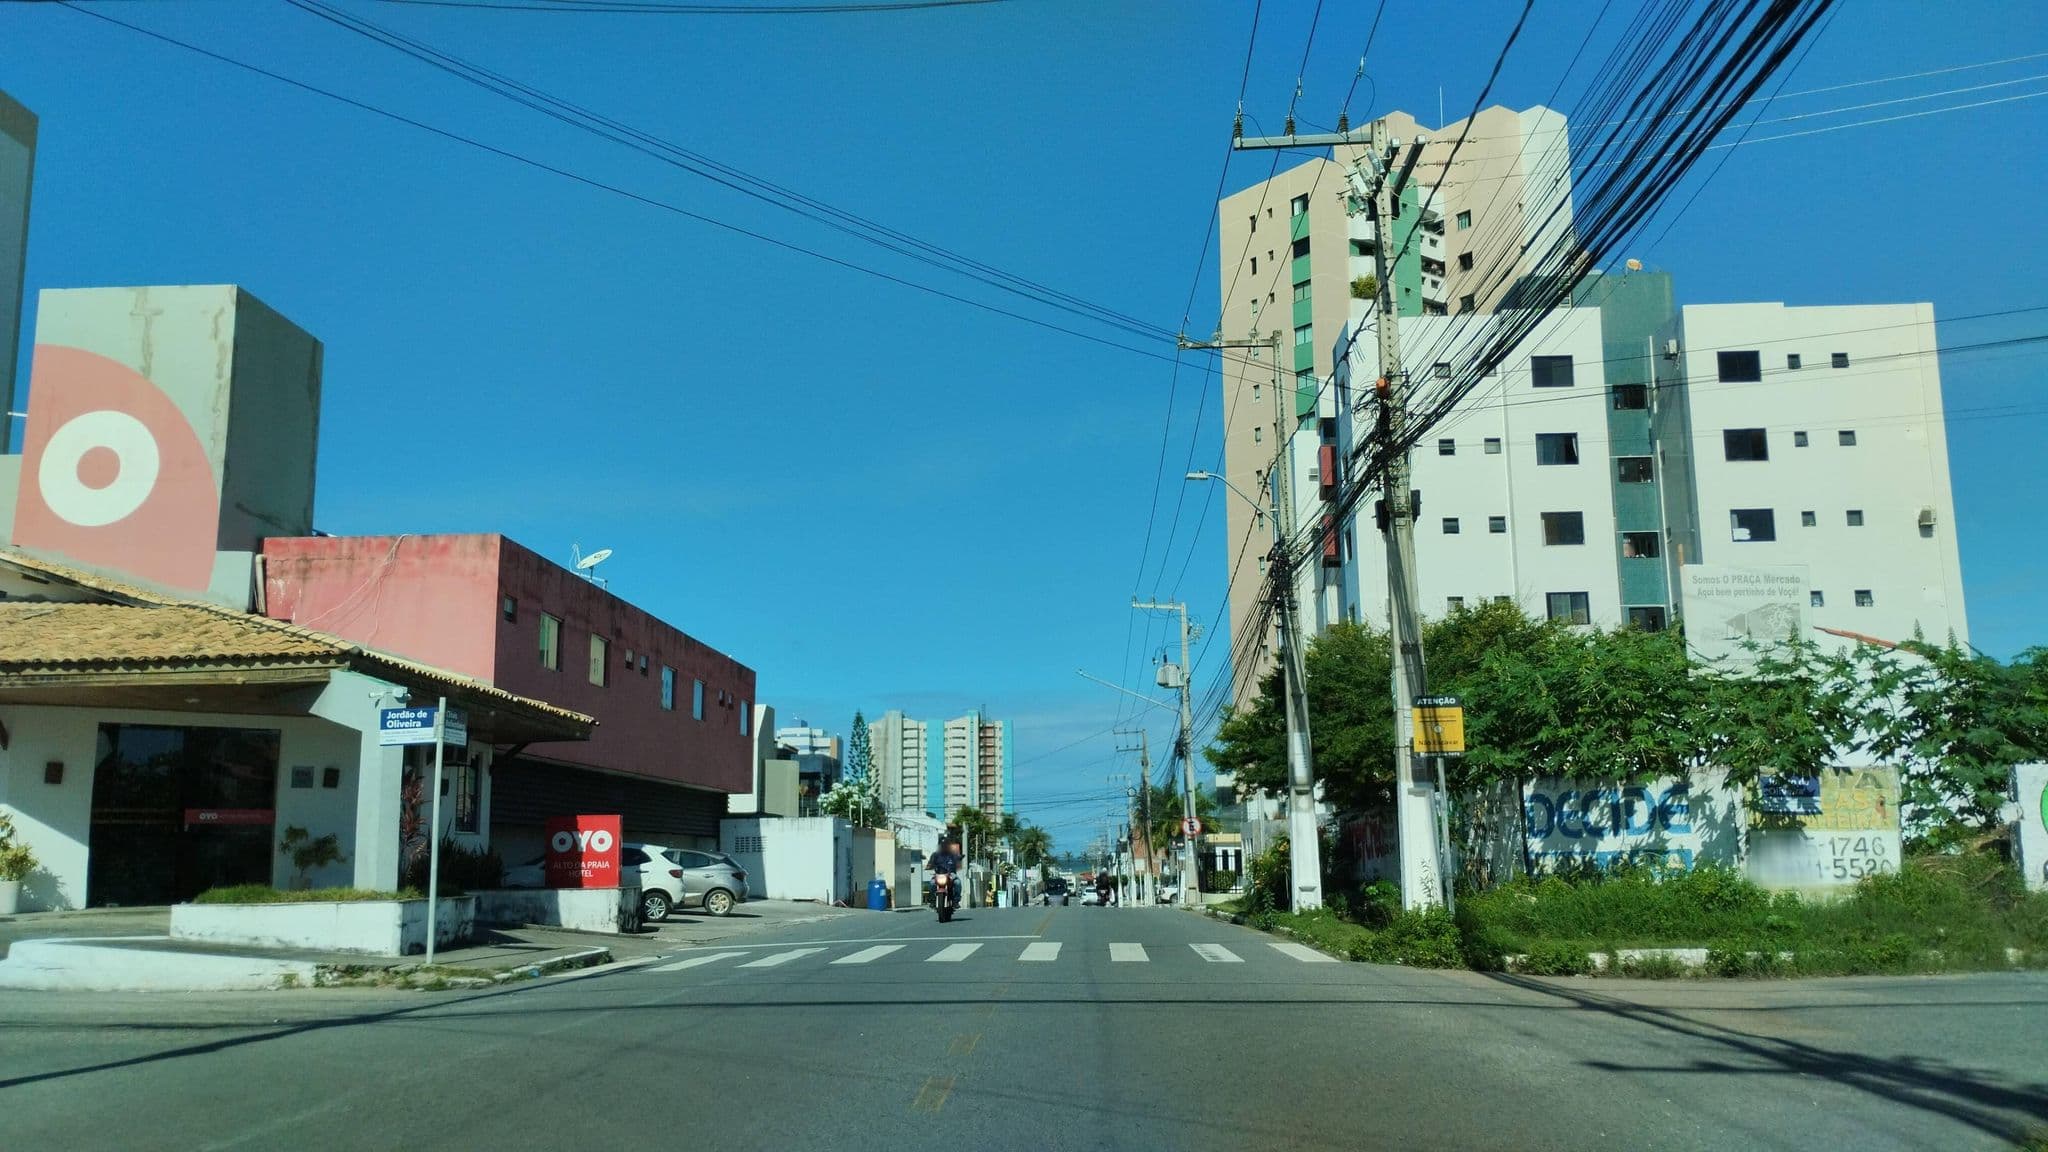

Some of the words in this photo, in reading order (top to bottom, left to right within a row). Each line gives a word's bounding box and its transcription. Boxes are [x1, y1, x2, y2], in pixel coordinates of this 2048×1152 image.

[1692, 575, 1721, 585] Somos
[1723, 575, 1729, 584] O
[1731, 574, 1760, 586] PRAÇA
[1763, 575, 1801, 584] Mercado
[1697, 588, 1714, 598] Aqui
[1716, 587, 1729, 596] bem
[1732, 587, 1765, 597] pertinho
[1766, 587, 1776, 596] de
[1417, 696, 1456, 706] ATENÇÃO
[386, 710, 416, 719] Jordão
[416, 710, 428, 719] de
[386, 719, 422, 729] Oliveira
[1526, 784, 1692, 839] DECIDE
[552, 830, 613, 852] OYO
[587, 860, 610, 869] PRAIA
[568, 869, 594, 877] HOTEL
